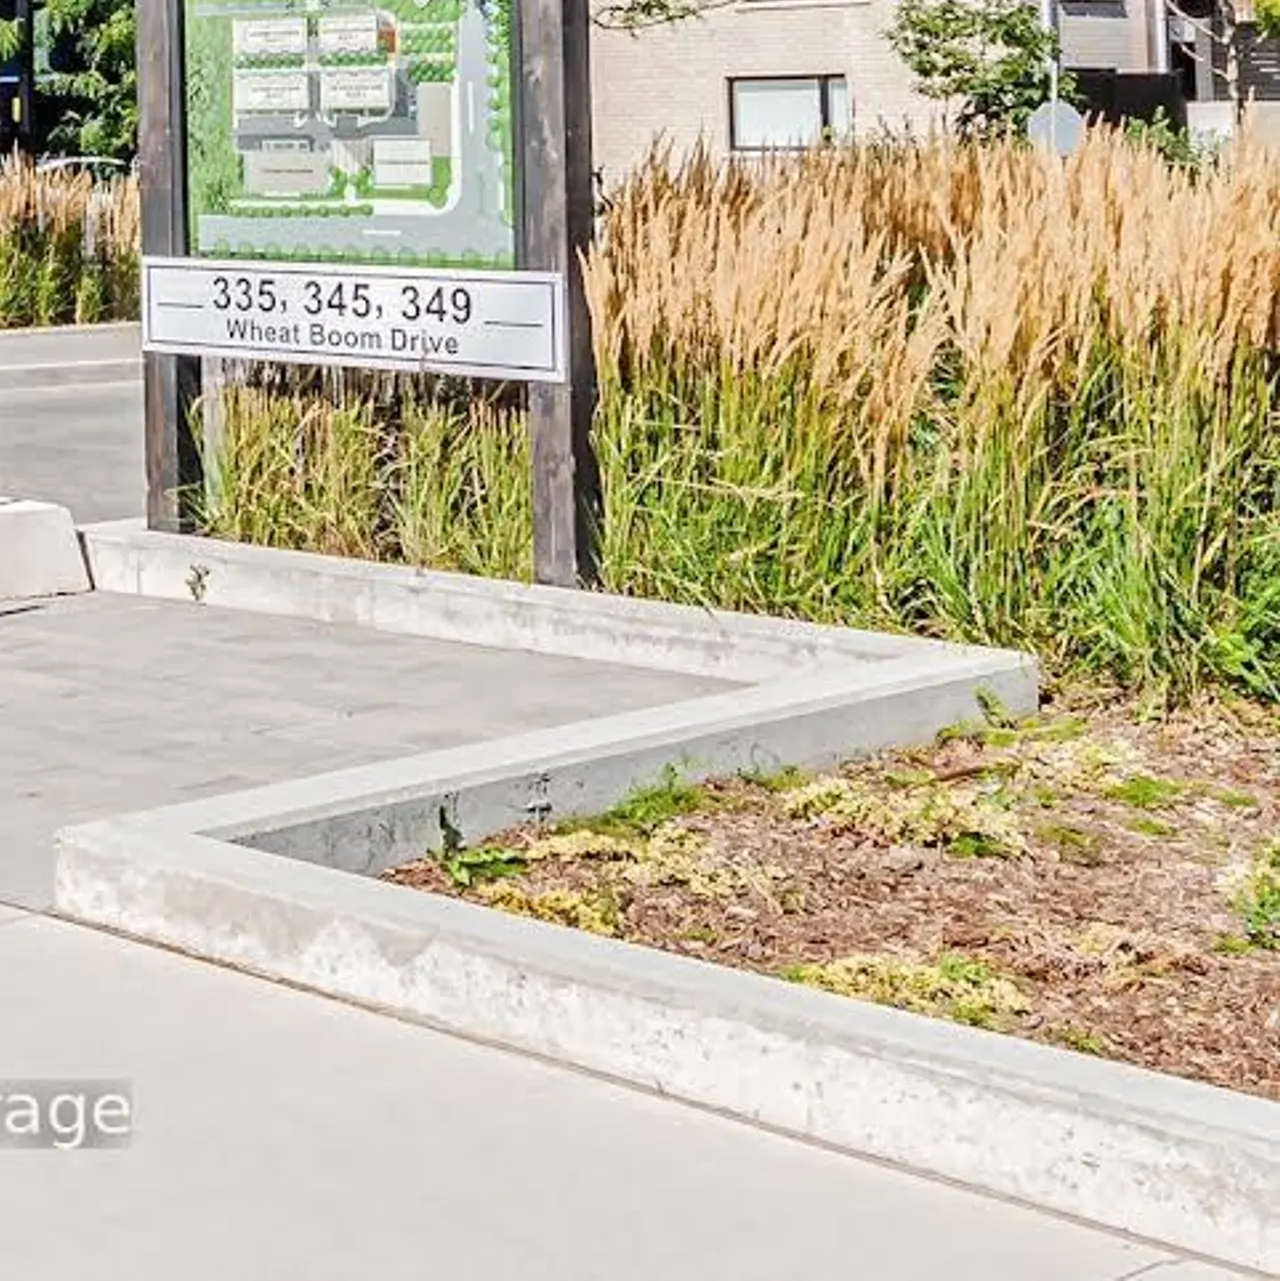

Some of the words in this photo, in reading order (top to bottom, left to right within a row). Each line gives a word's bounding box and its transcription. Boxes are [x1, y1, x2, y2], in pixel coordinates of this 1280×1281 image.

[212, 277, 288, 314] 335,
[303, 281, 383, 320] 345,
[401, 285, 472, 324] 349
[226, 317, 300, 344] Wheat
[310, 323, 382, 349] Boom
[391, 328, 459, 355] Drive
